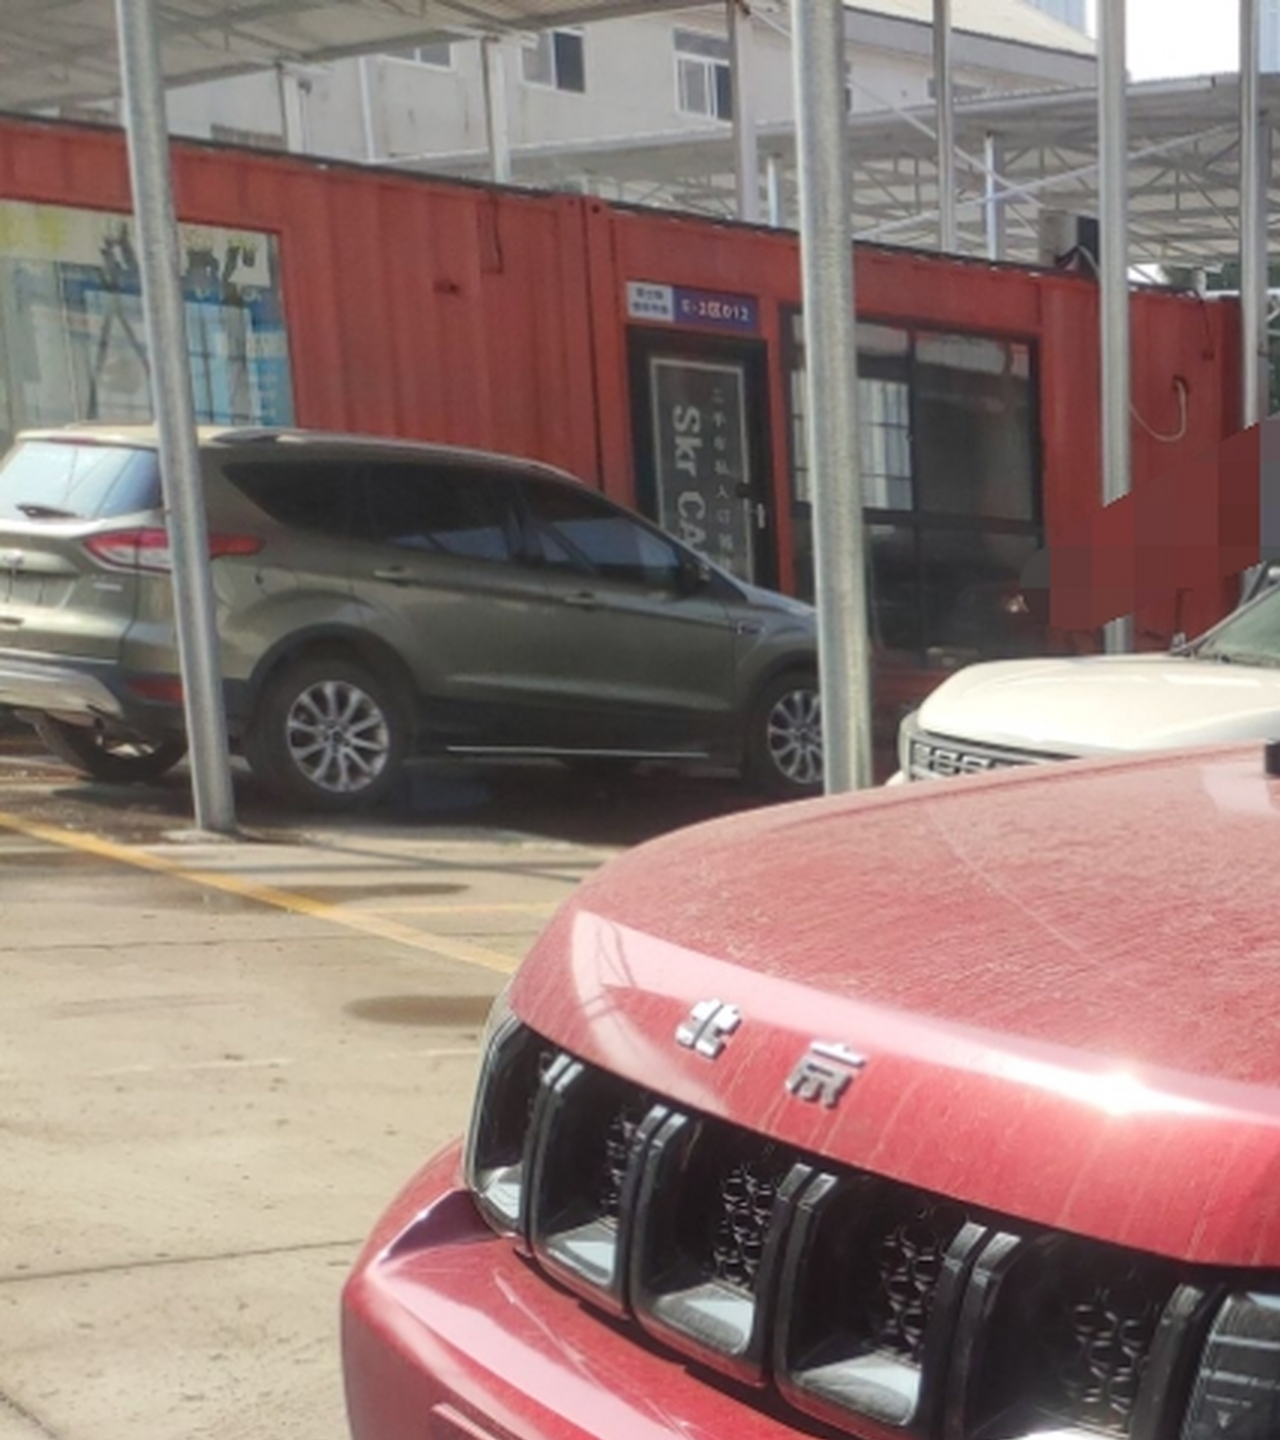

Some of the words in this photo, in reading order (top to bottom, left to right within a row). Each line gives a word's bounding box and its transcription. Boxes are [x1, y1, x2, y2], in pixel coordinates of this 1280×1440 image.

[672, 403, 702, 478] Skr
[677, 490, 708, 555] CA
[674, 998, 868, 1111] 北京
